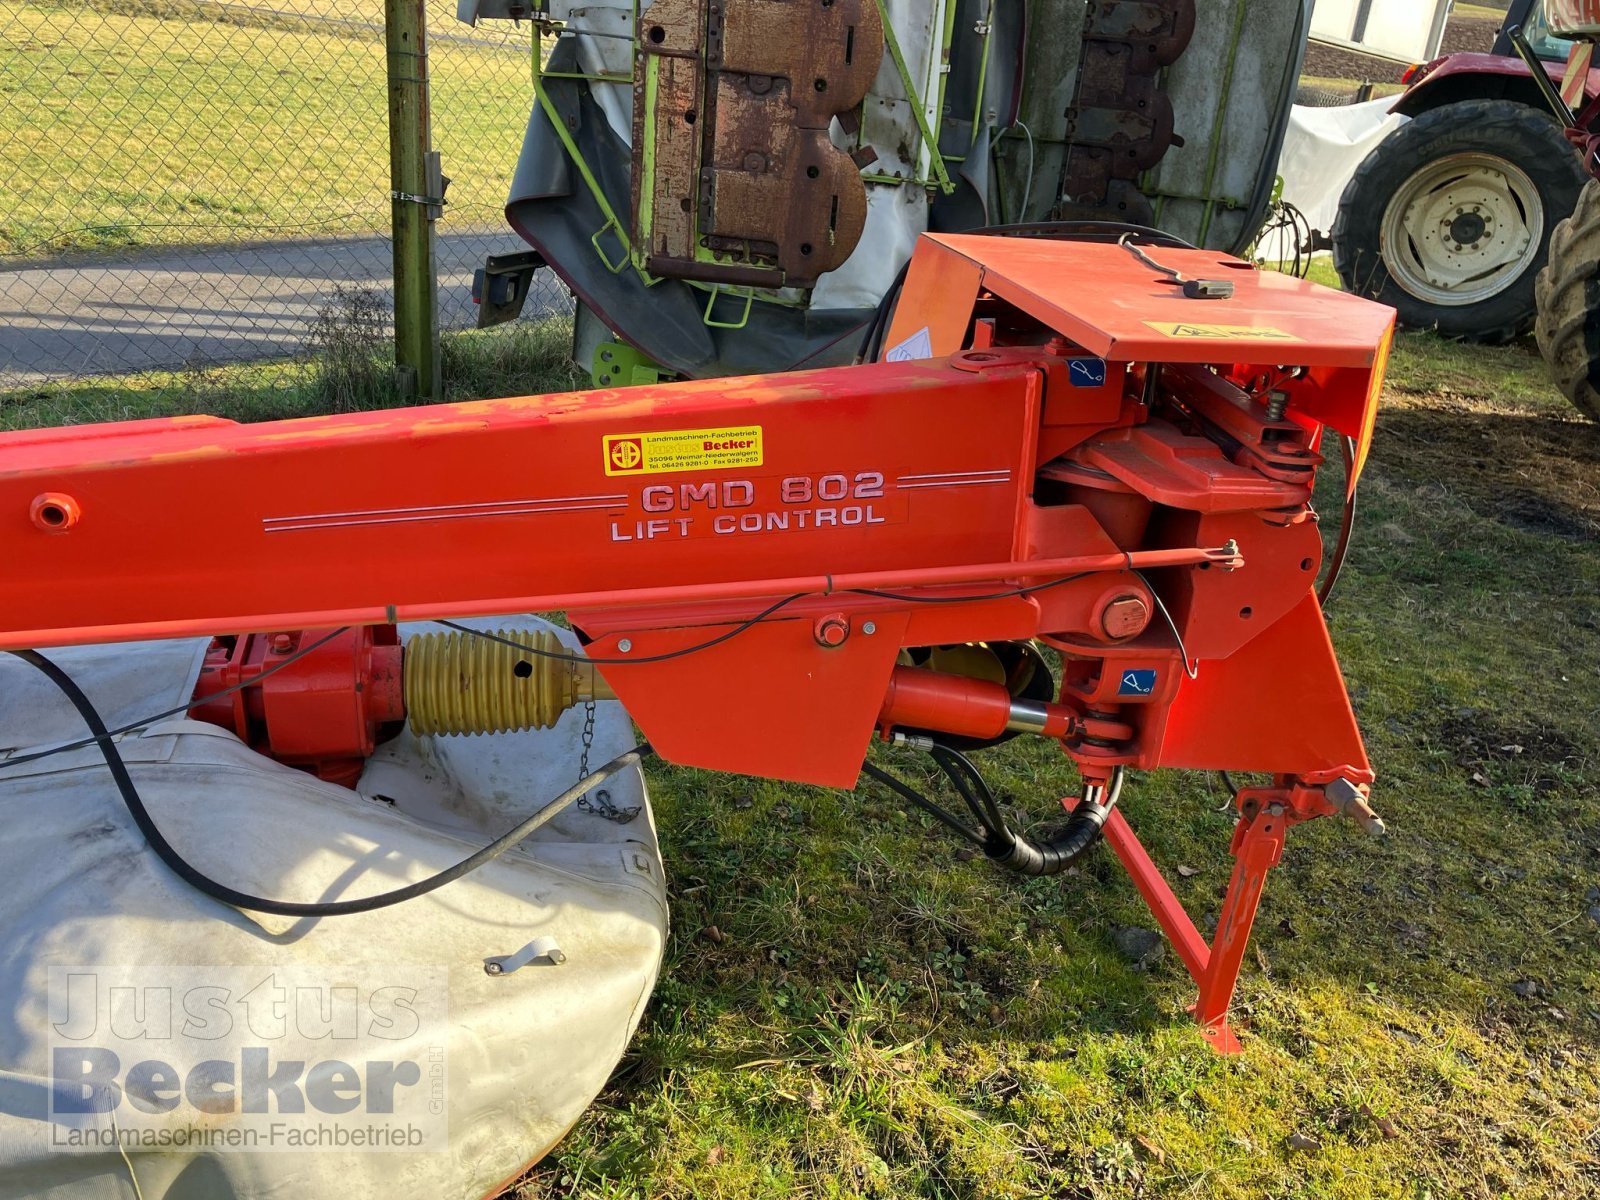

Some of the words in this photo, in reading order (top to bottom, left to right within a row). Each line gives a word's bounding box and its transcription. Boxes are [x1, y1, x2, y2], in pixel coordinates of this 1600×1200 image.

[647, 431, 758, 443] Landmaschinen-Fachbetrieb
[648, 443, 701, 455] Justus
[703, 440, 754, 451] Becker
[676, 451, 758, 461] Weimar-Niederwalgern
[727, 457, 758, 465] 9281-250
[641, 481, 754, 513] GMD
[781, 471, 885, 503] 802
[610, 519, 694, 543] LIFT
[714, 505, 885, 535] CONTROL
